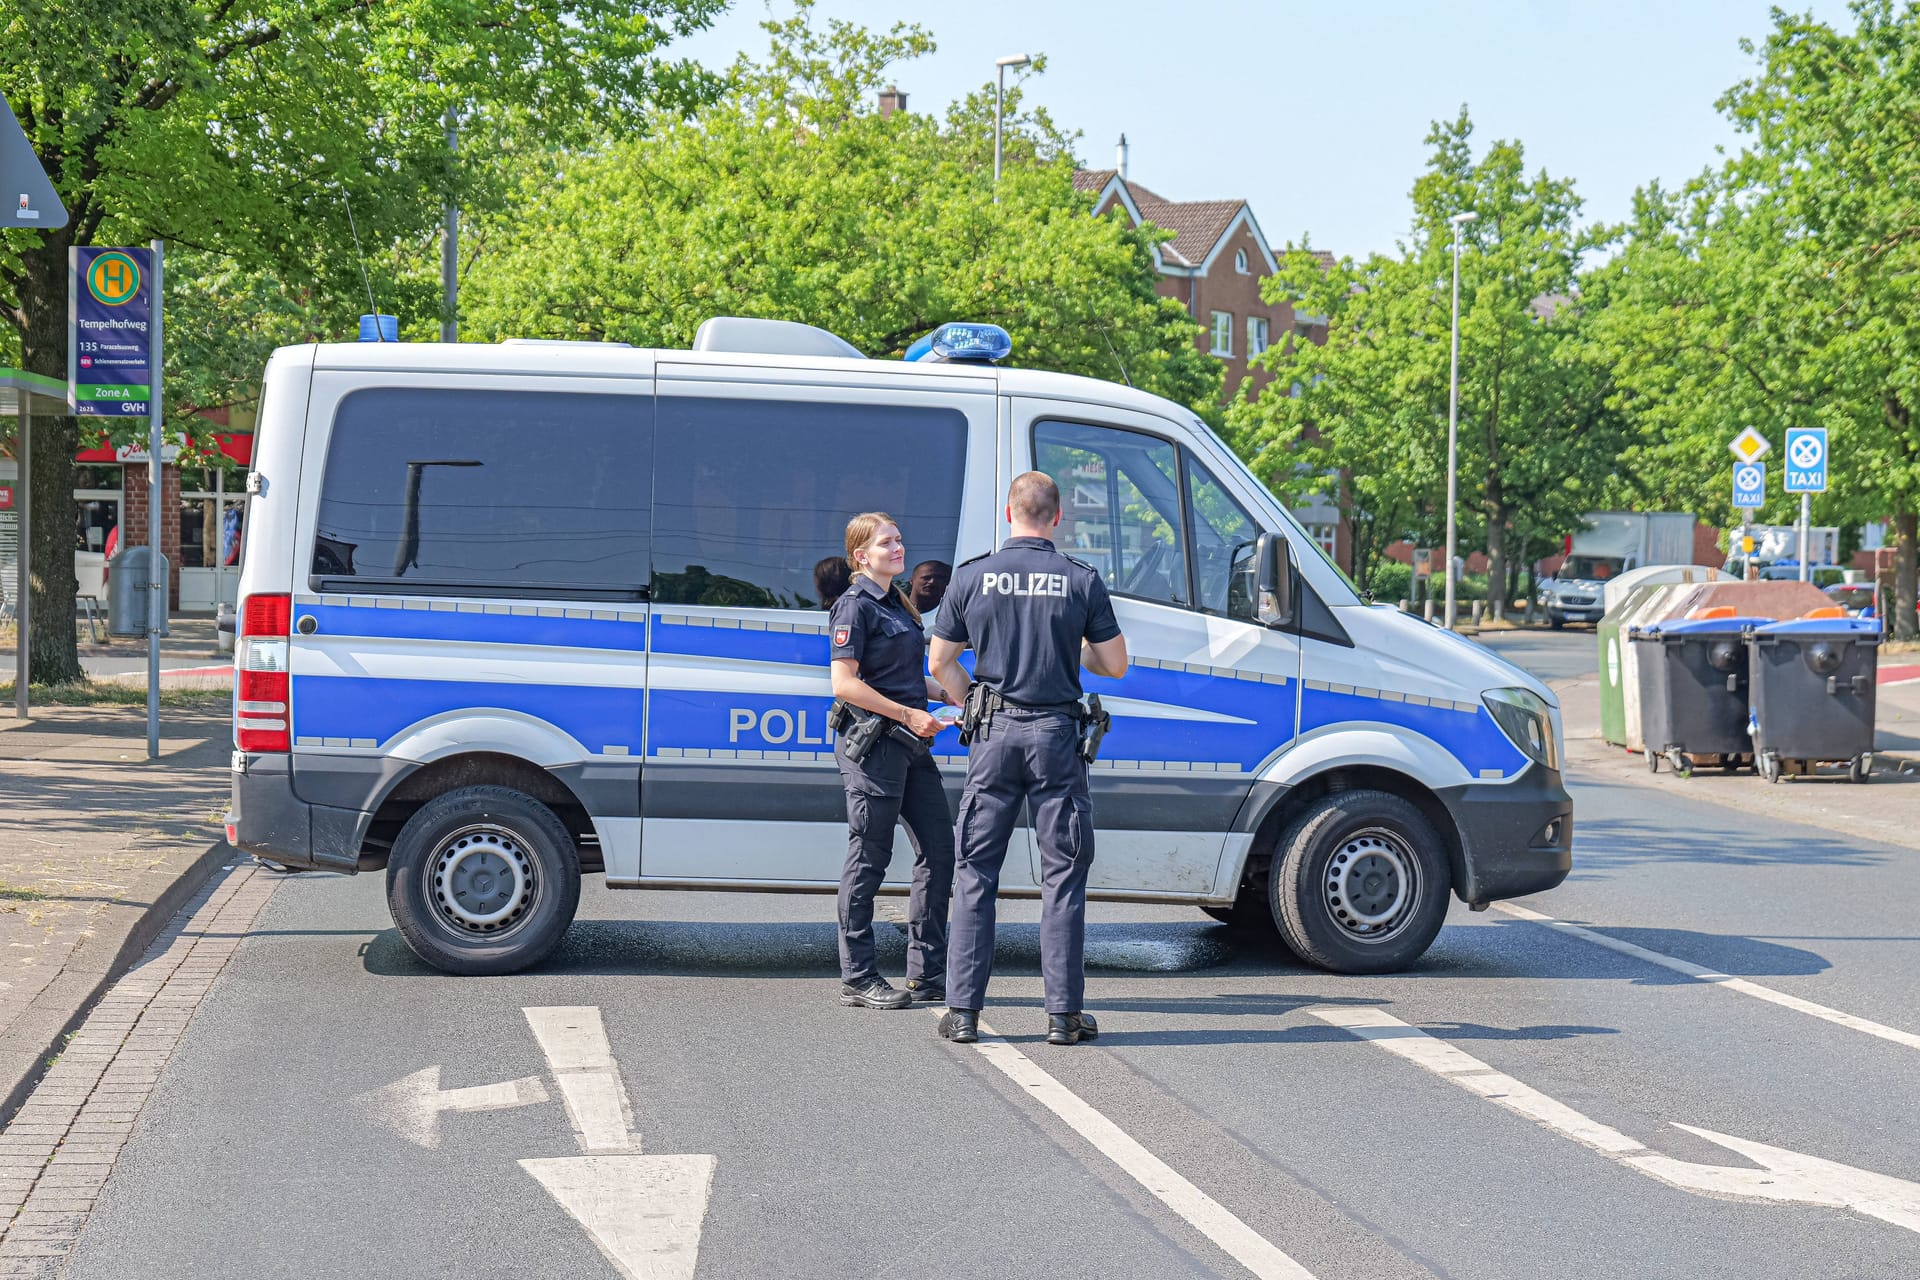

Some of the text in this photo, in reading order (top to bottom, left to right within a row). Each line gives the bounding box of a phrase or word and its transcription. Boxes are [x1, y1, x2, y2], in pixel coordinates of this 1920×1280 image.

[103, 264, 125, 293] H
[80, 319, 147, 331] Tempelhofweg
[80, 341, 97, 352] 135
[95, 387, 130, 398] Zone A
[121, 402, 146, 413] GVH
[1789, 471, 1823, 486] TAXI
[1735, 492, 1761, 503] TAXI
[982, 572, 1068, 598] POLIZEI
[729, 708, 834, 745] POLI
